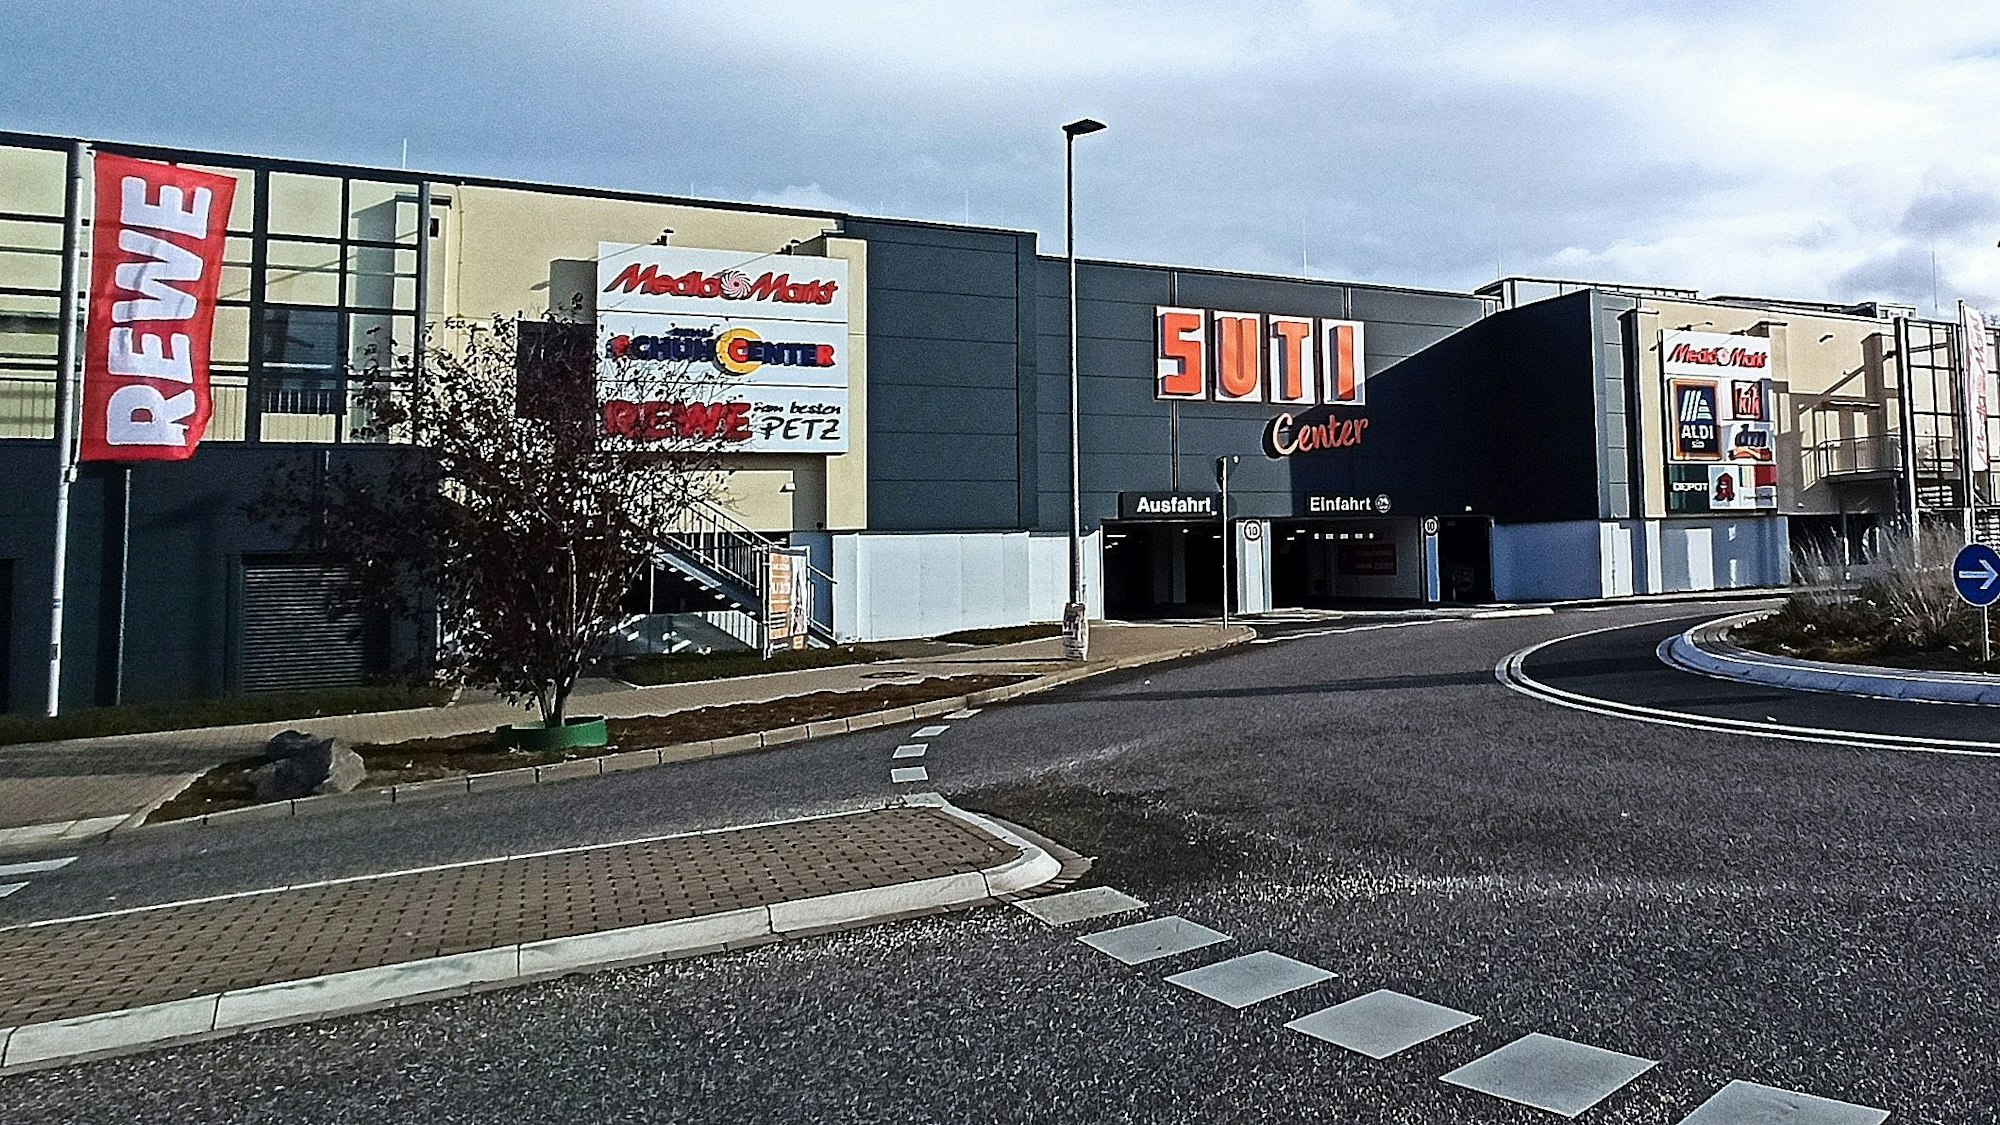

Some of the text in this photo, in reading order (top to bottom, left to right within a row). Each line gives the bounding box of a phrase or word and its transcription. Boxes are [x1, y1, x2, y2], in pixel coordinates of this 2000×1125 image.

[106, 176, 213, 446] REWE
[728, 337, 836, 367] CENTER
[1160, 312, 1355, 401] SUTI
[603, 400, 753, 440] REWE
[760, 416, 841, 440] PETZ
[1270, 411, 1369, 456] Center
[1681, 424, 1715, 441] ALDI
[1672, 481, 1709, 492] DEPOT
[1136, 496, 1211, 513] Ausfahrt
[1310, 496, 1372, 512] Einfahrt
[1246, 525, 1259, 537] 10
